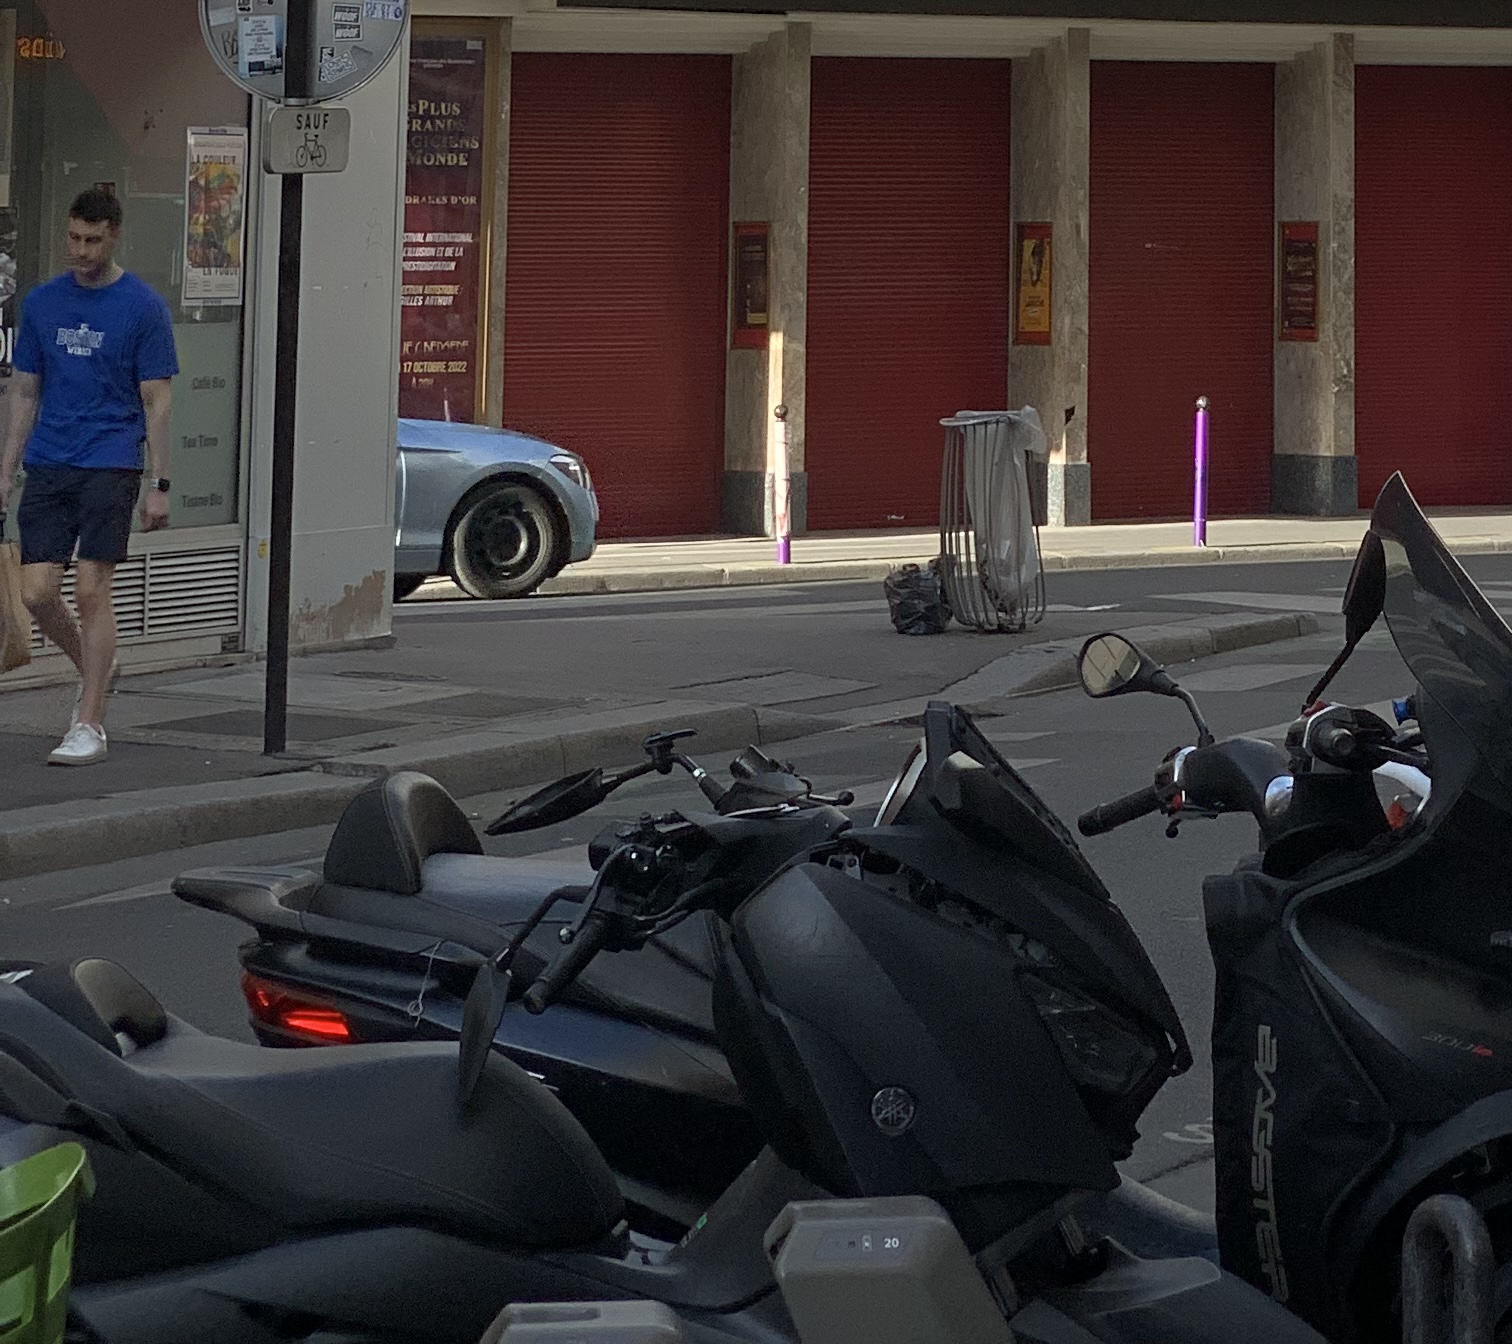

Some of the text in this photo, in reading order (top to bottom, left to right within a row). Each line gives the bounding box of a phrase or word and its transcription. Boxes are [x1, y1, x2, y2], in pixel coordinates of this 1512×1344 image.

[418, 99, 461, 116] PLUS
[296, 113, 329, 130] SAUF
[411, 135, 480, 150] GICIENS
[405, 195, 477, 205] DRAKES D'OR
[403, 233, 425, 243] STIVAL
[403, 361, 468, 373] 17 OCTOBRE 2022
[212, 376, 226, 389] Bio
[182, 436, 197, 449] Tea
[884, 1237, 900, 1249] 20
